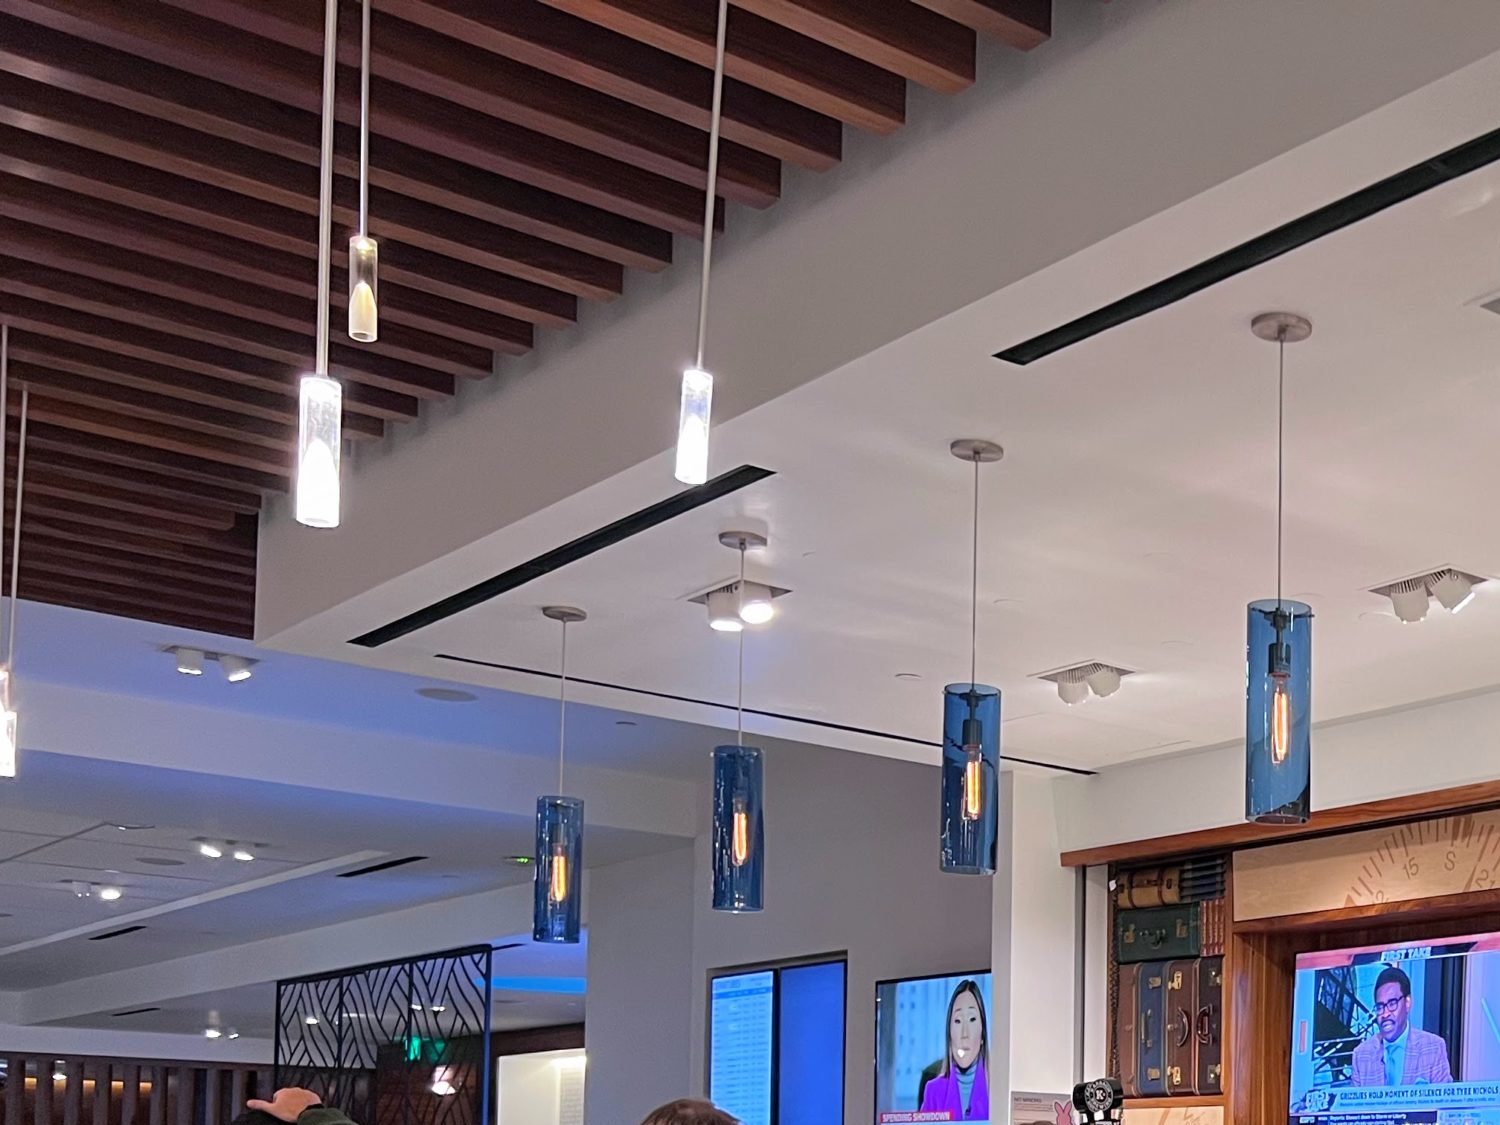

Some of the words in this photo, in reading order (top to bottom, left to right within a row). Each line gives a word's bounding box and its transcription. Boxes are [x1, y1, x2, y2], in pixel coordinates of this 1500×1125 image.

[1403, 857, 1419, 880] 15
[1444, 851, 1456, 871] S
[1380, 949, 1406, 962] FIRST
[1407, 946, 1432, 960] TAKE
[1340, 1092, 1368, 1100] GRIZZLIES
[1368, 1091, 1383, 1099] HOLD
[1384, 1090, 1408, 1099] MOMENT
[1410, 1089, 1418, 1097] OF
[1418, 1088, 1442, 1097] SILENCE
[1443, 1088, 1455, 1096] FOR
[1456, 1087, 1471, 1096] TYRE
[1473, 1086, 1499, 1095] NICHOLS
[882, 1113, 912, 1122] SPENDING
[913, 1112, 950, 1121] SHOWDOWN
